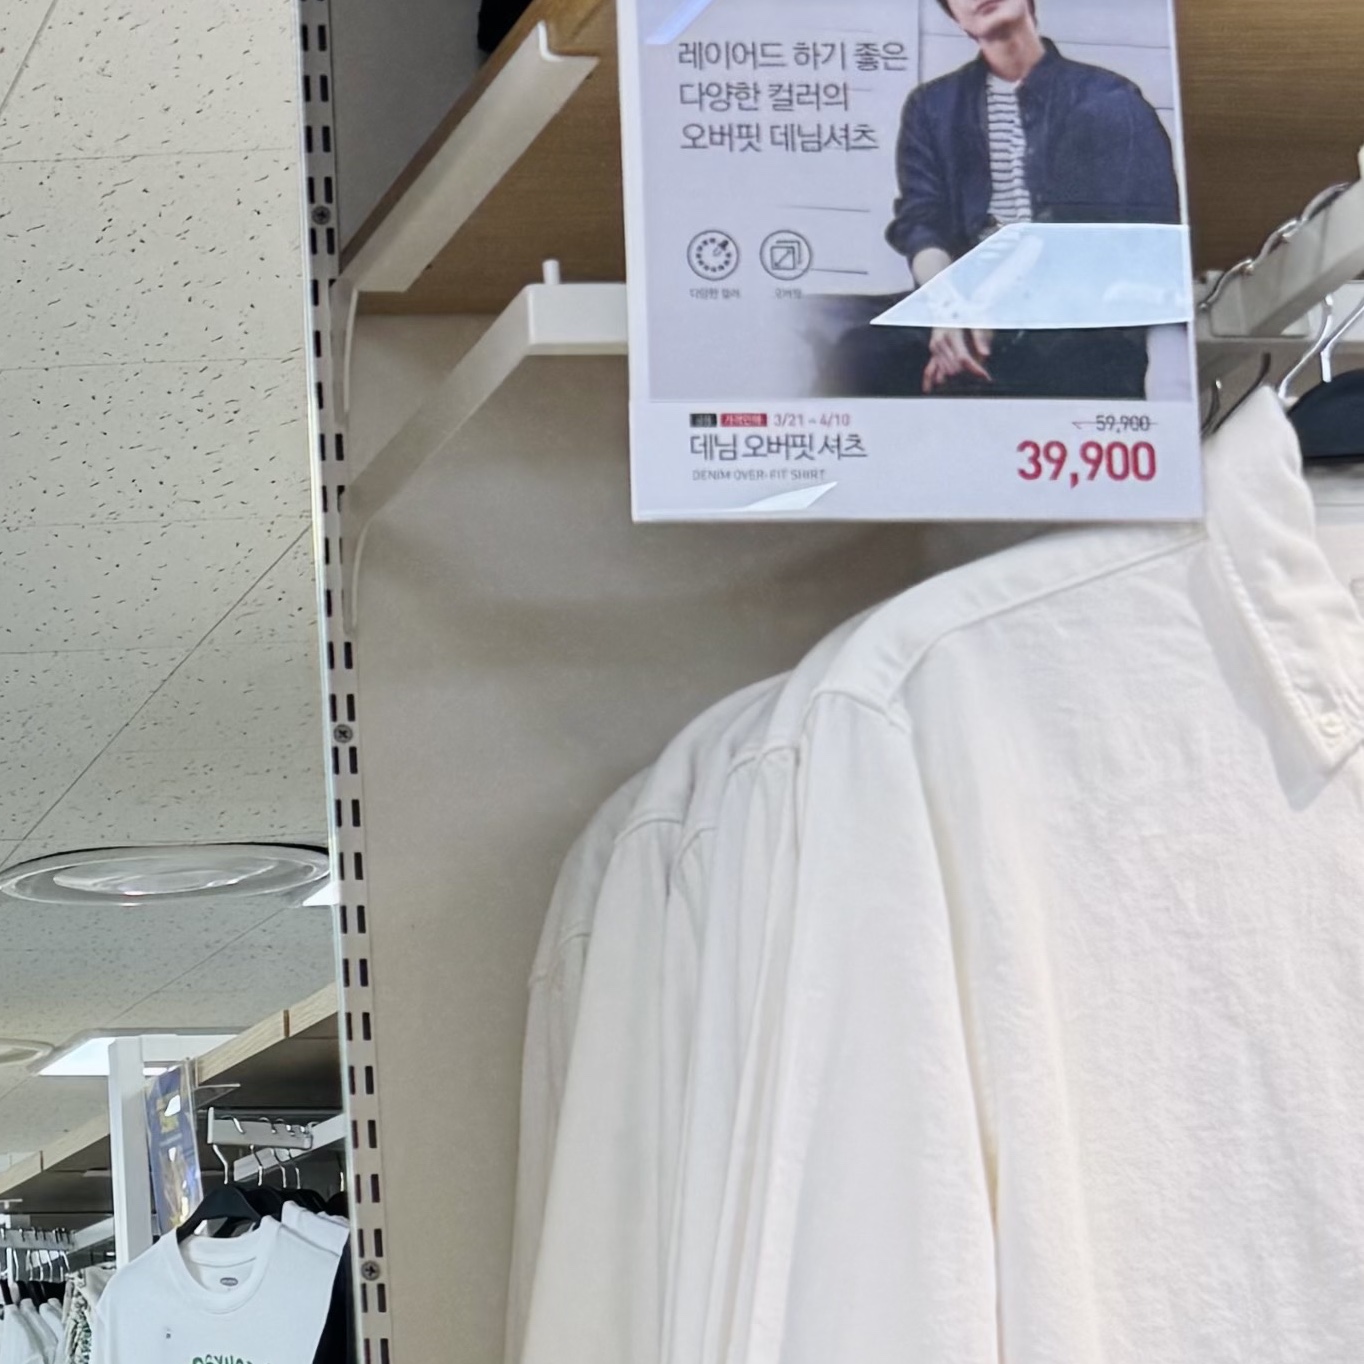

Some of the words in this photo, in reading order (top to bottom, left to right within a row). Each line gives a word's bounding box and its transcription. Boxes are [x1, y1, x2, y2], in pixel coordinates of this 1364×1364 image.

[678, 41, 788, 71] 레이어드
[793, 41, 847, 71] 하기
[853, 41, 909, 72] 좋은
[679, 82, 761, 112] 다양한
[768, 82, 849, 112] 컬러의
[680, 123, 763, 152] 오버핏
[769, 123, 880, 152] 데님셔츠
[773, 413, 804, 427] 3/21
[819, 413, 850, 427] 4/10
[1095, 414, 1151, 433] 59,900
[690, 433, 738, 461] 데님
[742, 433, 815, 461] 오버핏
[818, 433, 868, 460] 셔츠
[692, 470, 731, 481] DENIM
[791, 468, 827, 480] SHIRT
[1015, 440, 1157, 489] 39,900
